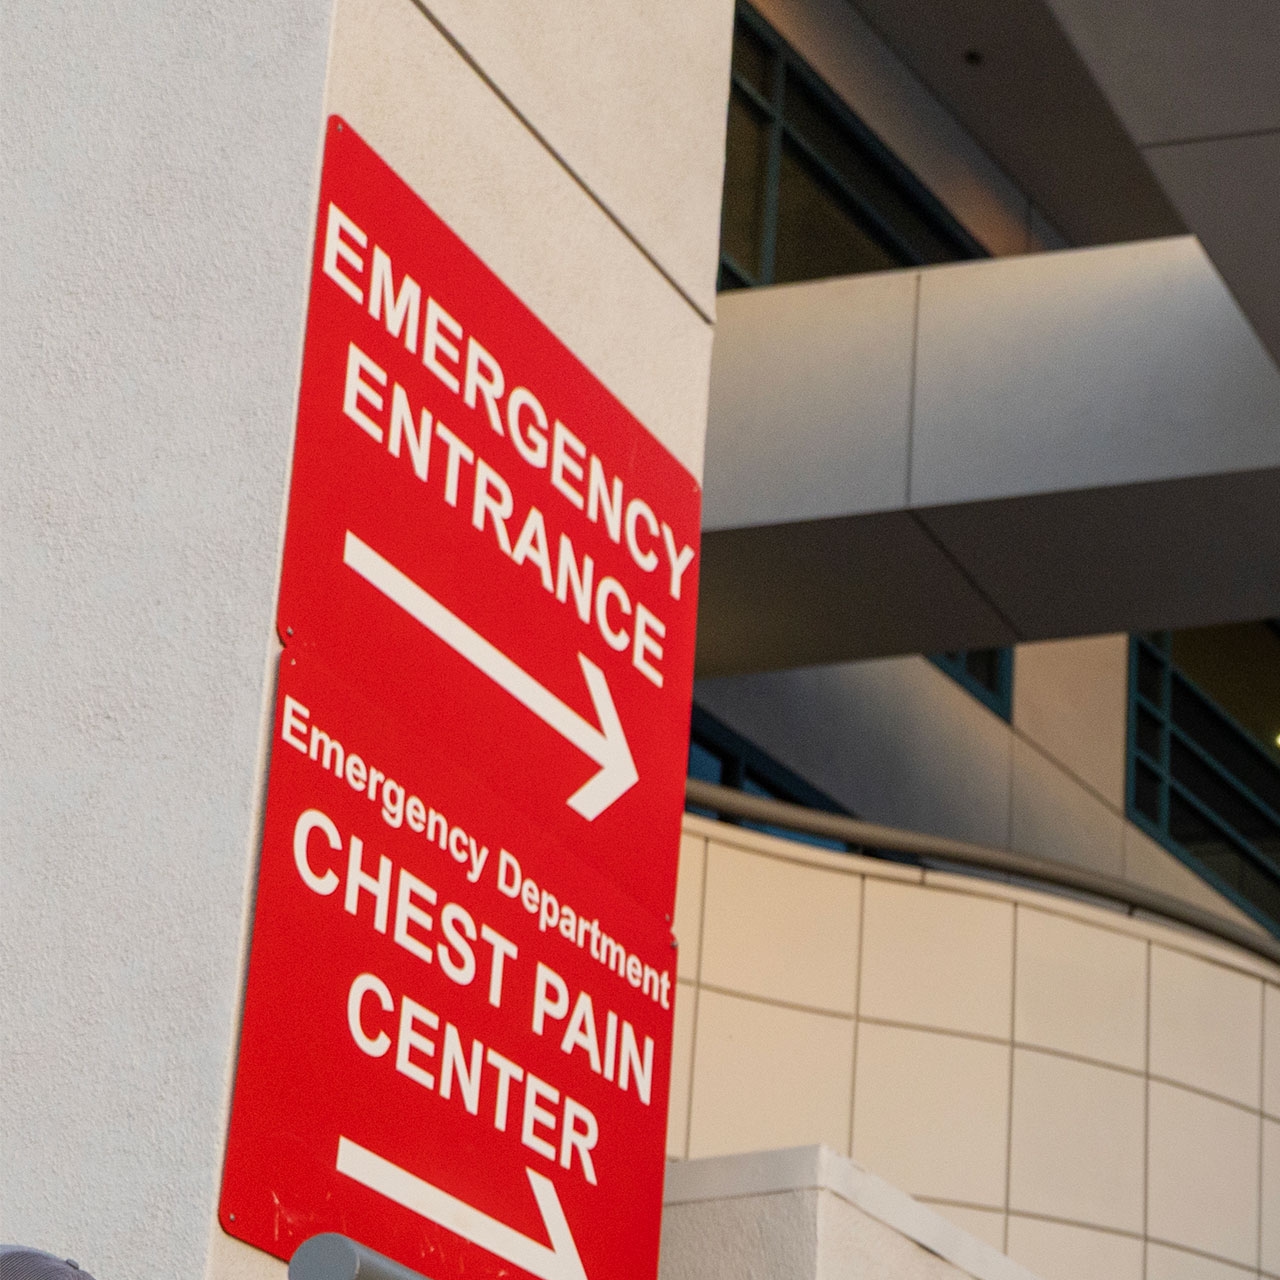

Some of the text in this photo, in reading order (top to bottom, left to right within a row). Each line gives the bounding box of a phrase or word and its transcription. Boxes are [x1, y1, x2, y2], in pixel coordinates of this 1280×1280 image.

[322, 201, 695, 600] EMERGENCY
[342, 341, 667, 688] ENTRANCE
[281, 694, 671, 1010] Emergency Department
[293, 808, 655, 1106] CHEST PAIN
[347, 973, 599, 1186] CENTER
